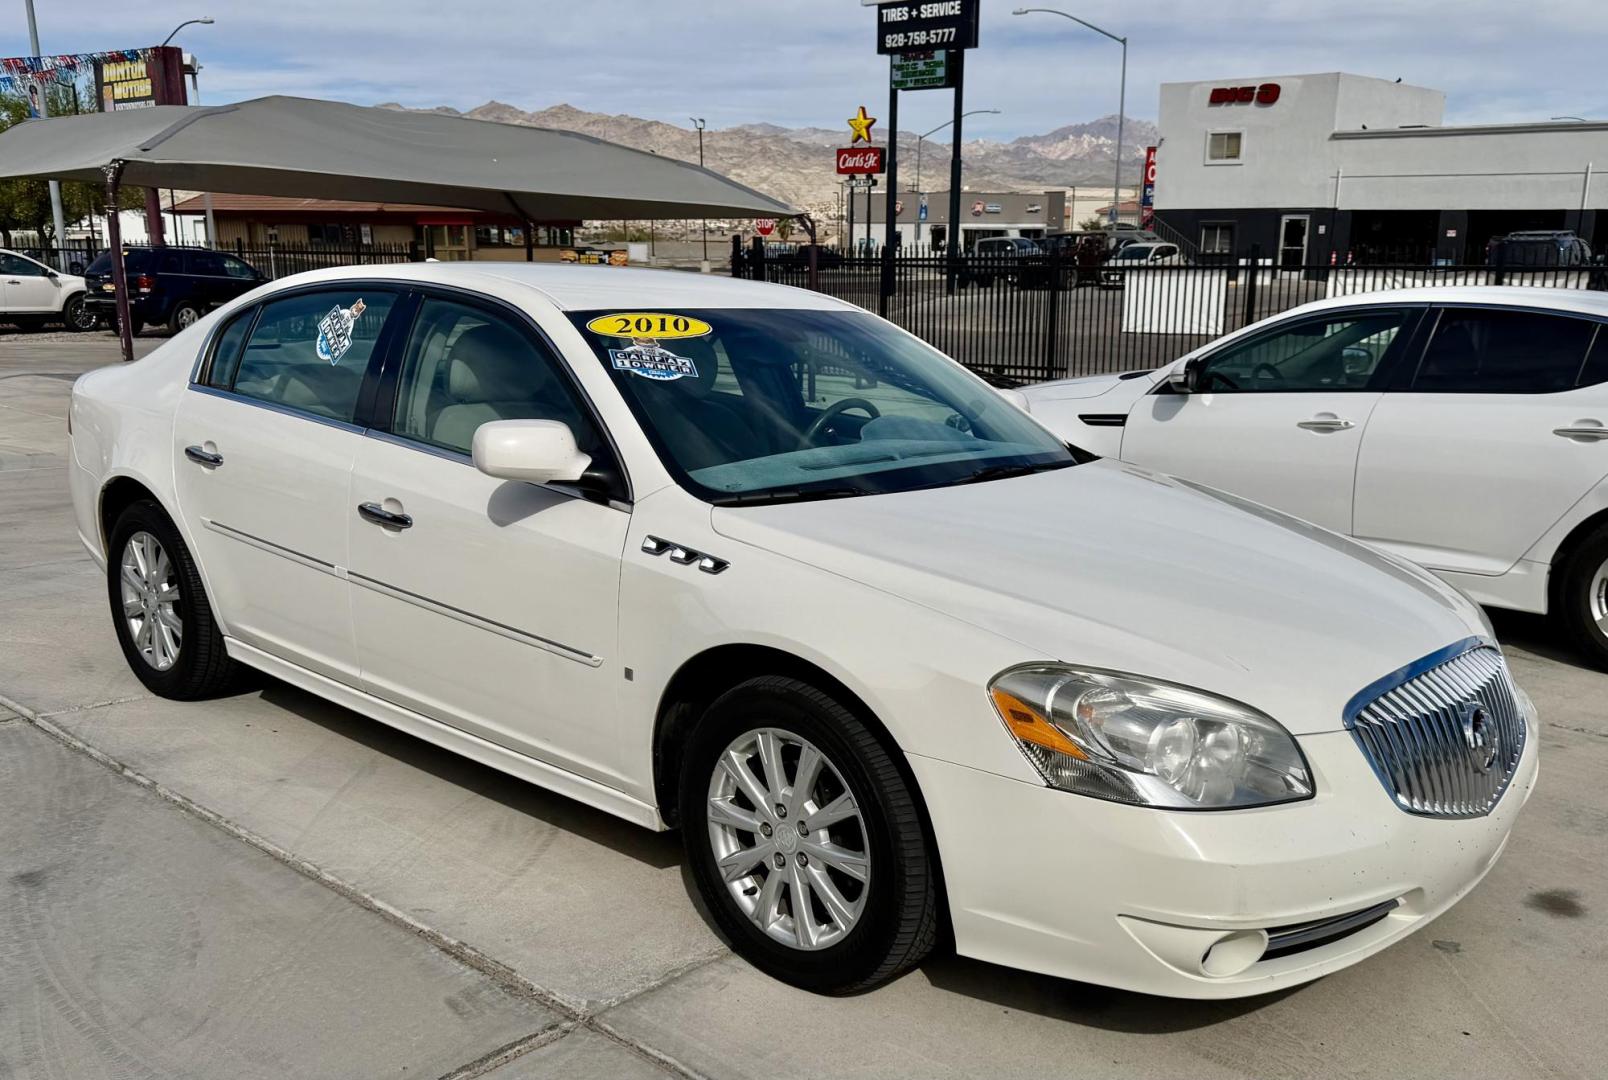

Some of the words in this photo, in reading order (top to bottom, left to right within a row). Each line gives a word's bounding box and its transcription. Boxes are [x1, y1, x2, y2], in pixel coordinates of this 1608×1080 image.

[882, 7, 909, 23] TIRES
[911, 10, 918, 18] +
[920, 1, 962, 19] SERVICE
[885, 27, 956, 48] 928-758-5777
[113, 78, 152, 100] MOTORS
[839, 152, 864, 169] Carl's
[757, 218, 774, 229] STOP
[615, 317, 690, 334] 2010
[616, 352, 689, 366] CARFAX
[631, 360, 691, 374] OWNER
